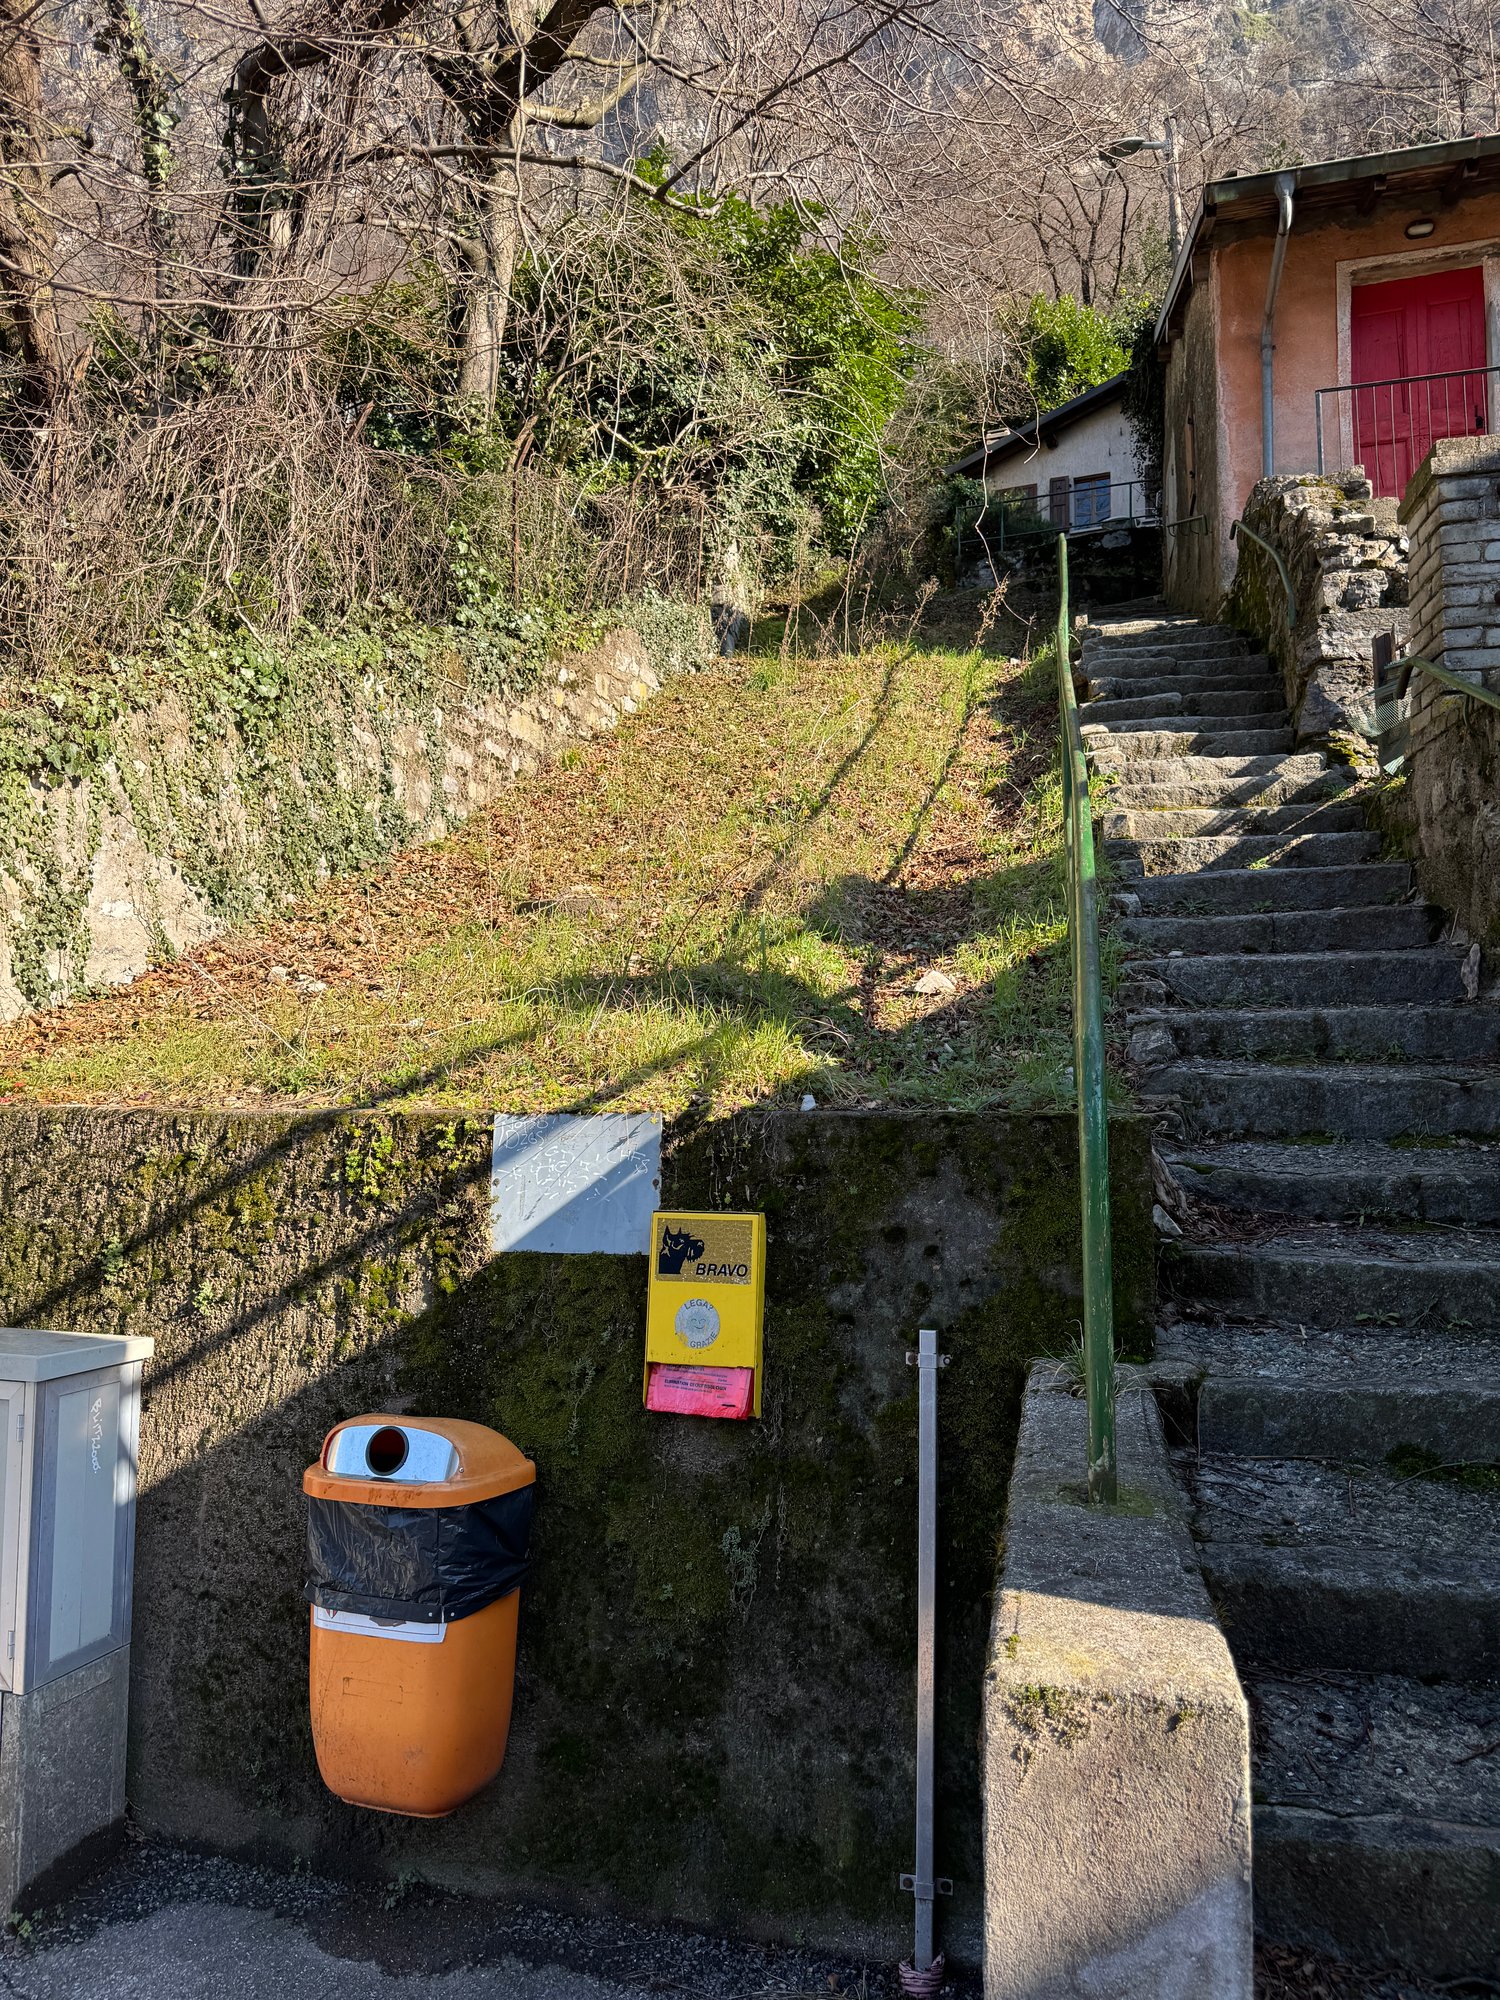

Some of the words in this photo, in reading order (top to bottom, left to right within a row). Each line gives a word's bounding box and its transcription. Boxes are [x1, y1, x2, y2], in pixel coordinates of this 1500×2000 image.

[695, 1262, 748, 1277] BRAVO
[684, 1299, 714, 1311] LEGA?
[690, 1331, 717, 1349] GRAZIE
